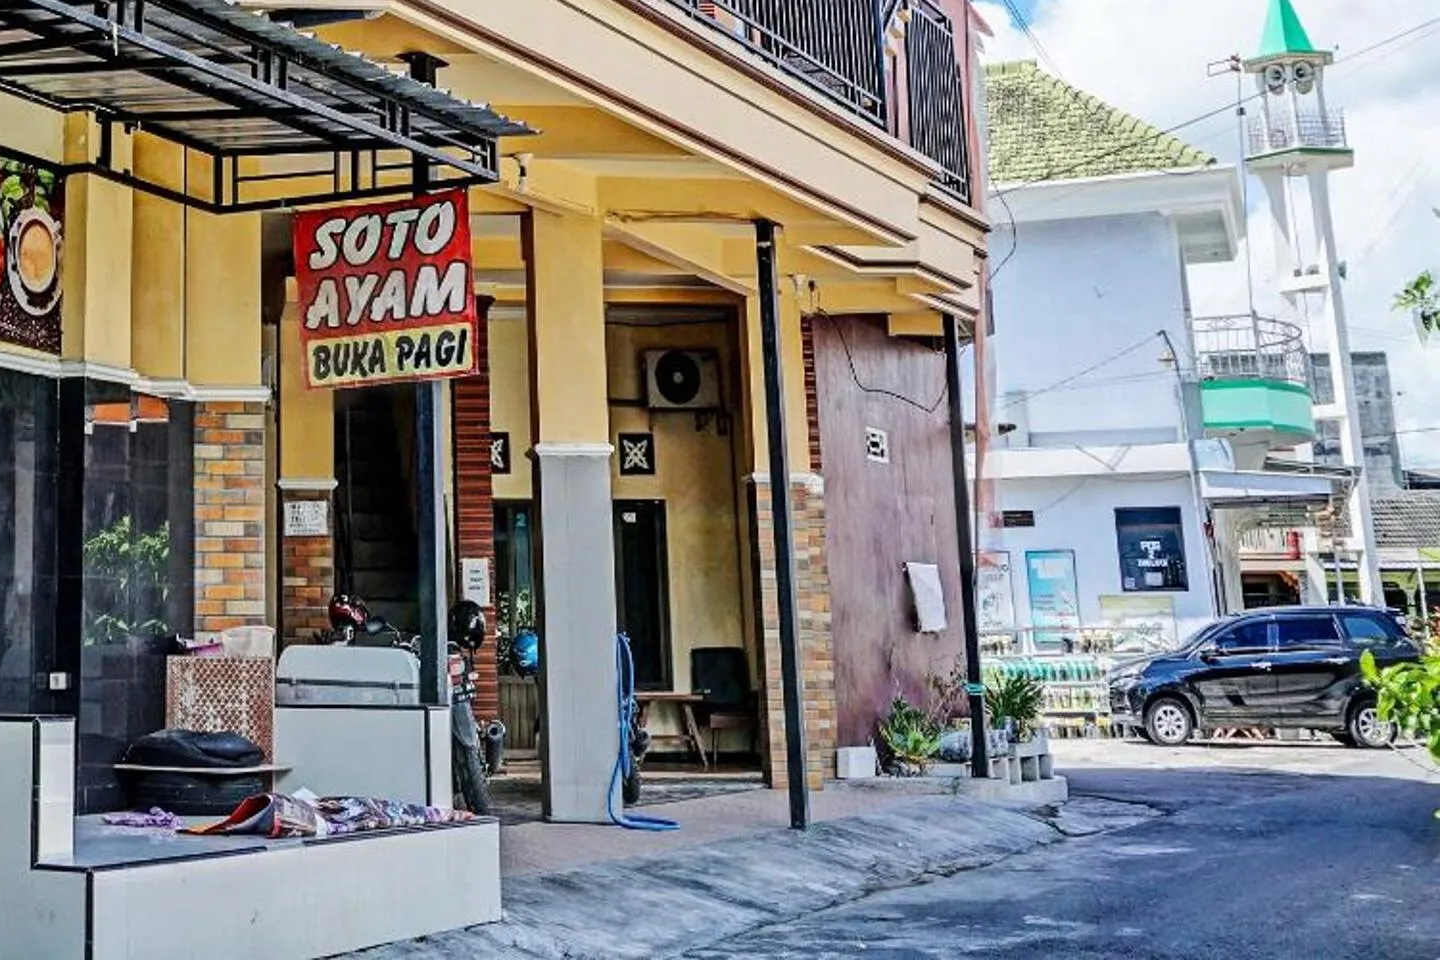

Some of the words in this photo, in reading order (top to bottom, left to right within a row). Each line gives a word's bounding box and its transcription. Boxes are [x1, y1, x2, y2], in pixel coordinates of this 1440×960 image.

[309, 200, 456, 270] SOTO
[305, 261, 468, 330] AYAM
[312, 339, 386, 381] BUKA
[394, 328, 468, 372] PAGI
